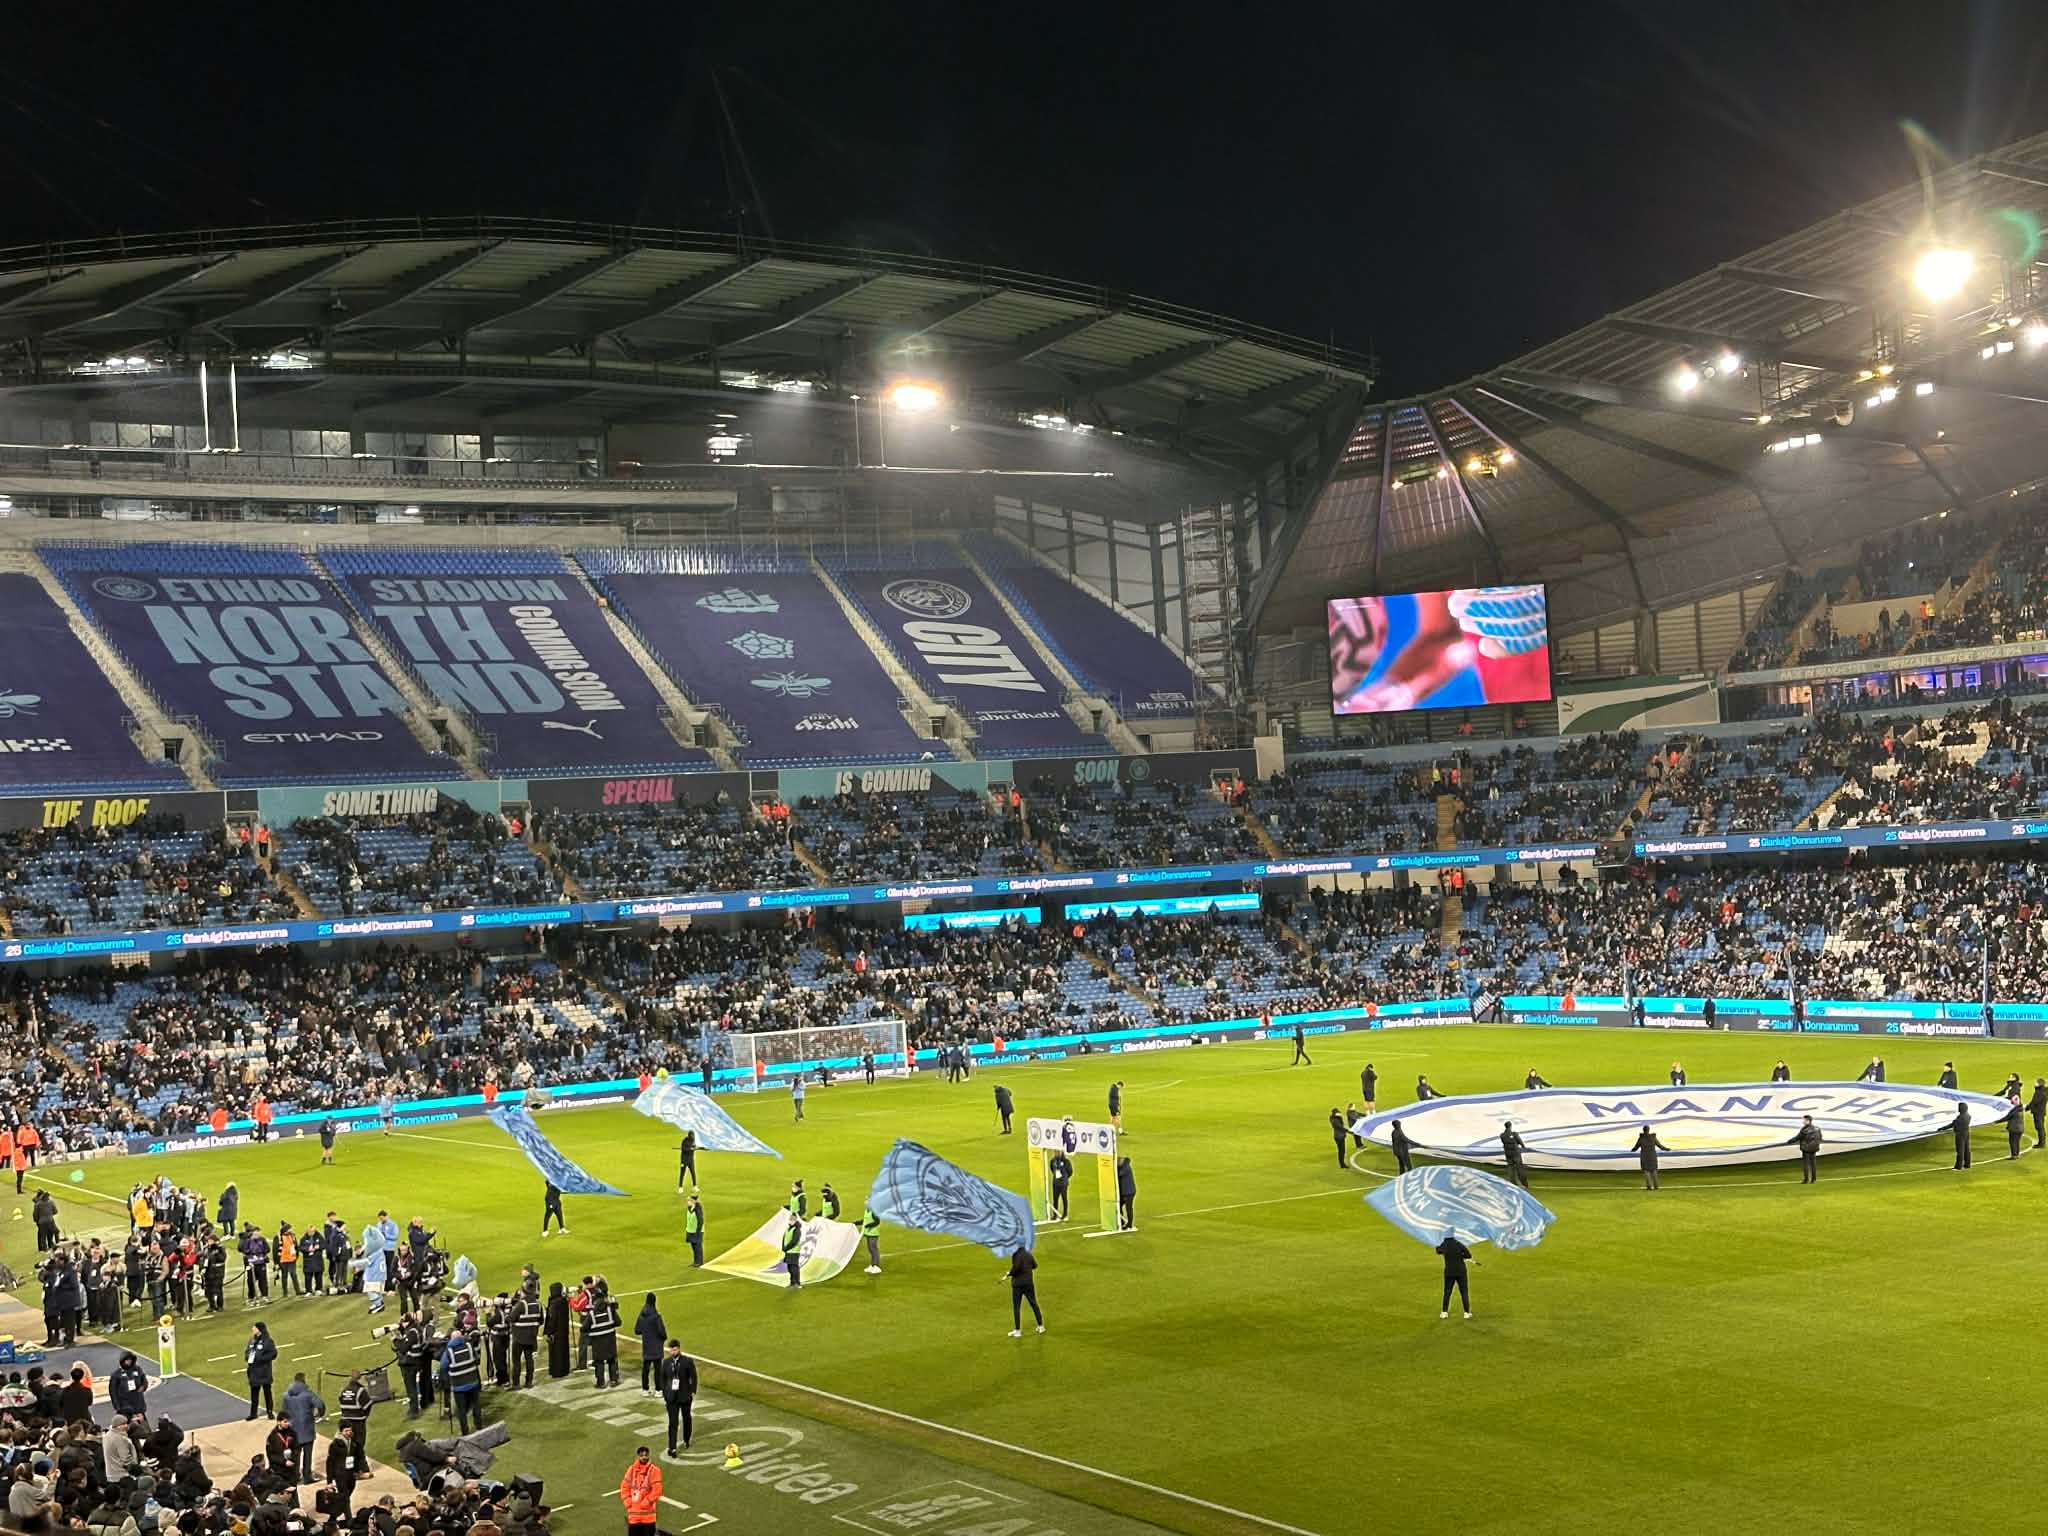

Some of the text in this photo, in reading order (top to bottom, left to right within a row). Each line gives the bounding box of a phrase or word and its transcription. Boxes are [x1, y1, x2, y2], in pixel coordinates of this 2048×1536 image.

[157, 578, 320, 601] ETIHAD
[369, 579, 568, 601] STADIUM
[144, 605, 515, 664] NORTH
[509, 605, 625, 711] COMING SOON
[902, 621, 1046, 693] CITY
[208, 664, 565, 720] STAND
[243, 731, 384, 743] ETIHAD
[795, 717, 859, 731] Asahi
[835, 768, 932, 794] IS COMING
[1073, 759, 1119, 784] SOON
[324, 788, 438, 817] SOMETHING
[602, 778, 673, 805] SPECIAL
[43, 798, 150, 828] THE ROOF
[1886, 1022, 1899, 1032] 25
